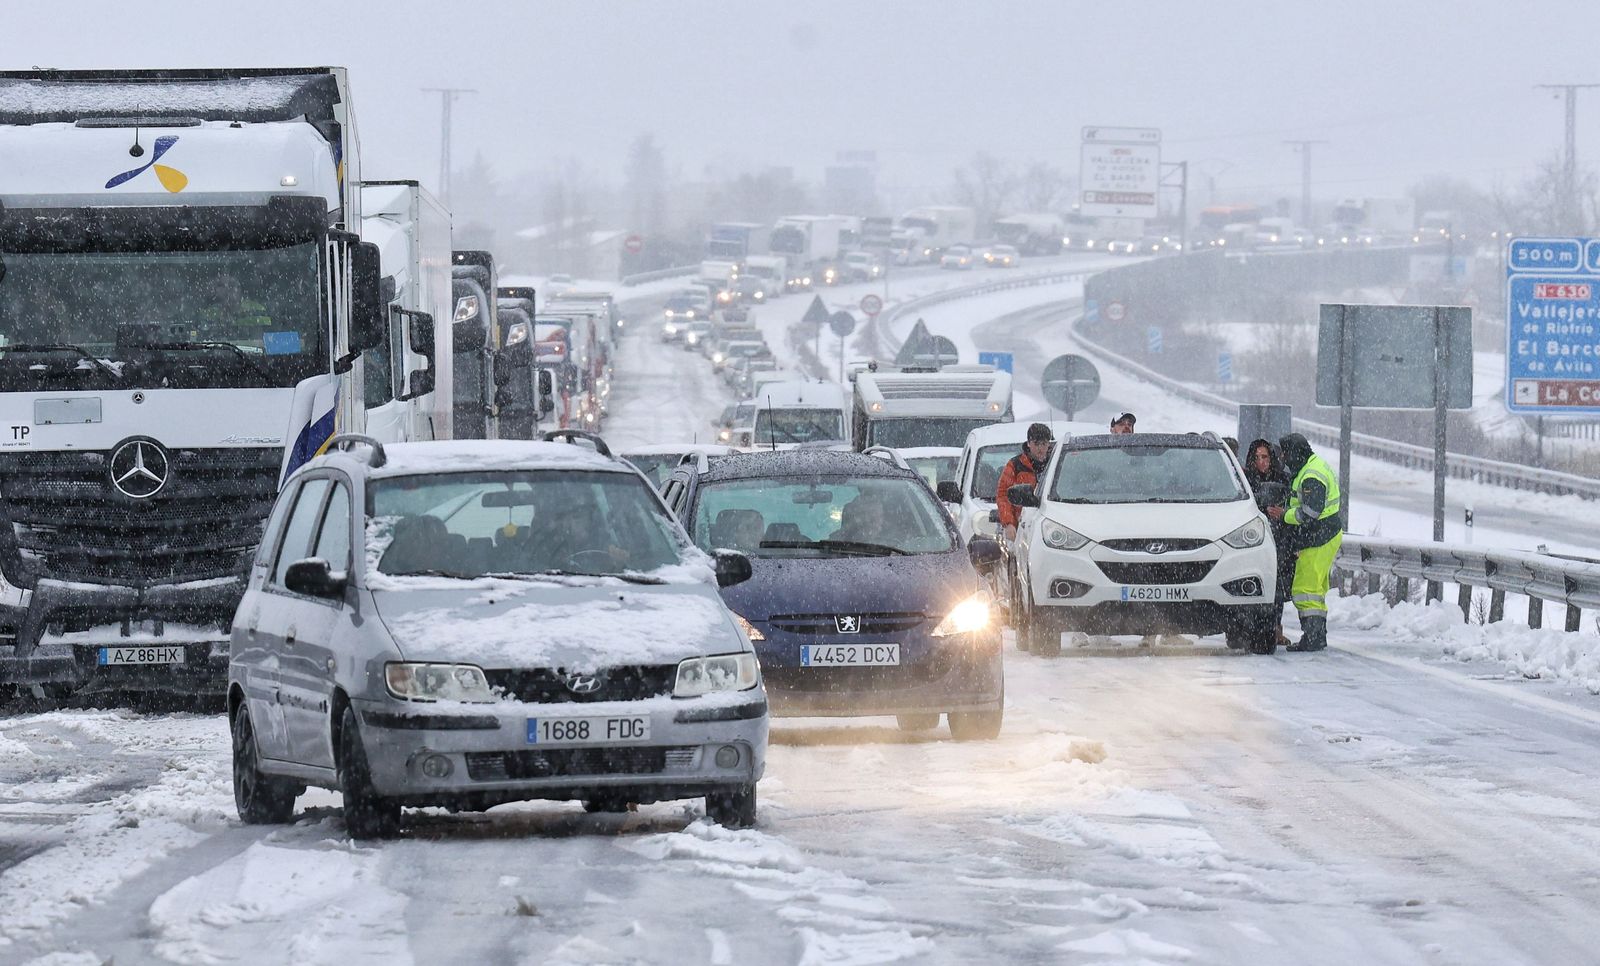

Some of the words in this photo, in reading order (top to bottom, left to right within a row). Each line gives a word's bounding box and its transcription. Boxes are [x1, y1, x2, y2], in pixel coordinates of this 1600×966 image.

[1518, 248, 1554, 261] 500
[1559, 251, 1573, 261] m
[1536, 285, 1589, 298] N-630
[1523, 322, 1539, 334] de
[1518, 339, 1538, 355] El
[1528, 361, 1544, 371] de
[1546, 385, 1569, 401] La
[11, 425, 30, 440] TP
[1130, 588, 1162, 600] 4620
[1166, 588, 1189, 600] HMX
[813, 647, 857, 663] 4452
[863, 646, 895, 663] DCX
[542, 720, 590, 741] 1688
[607, 718, 644, 739] FDG
